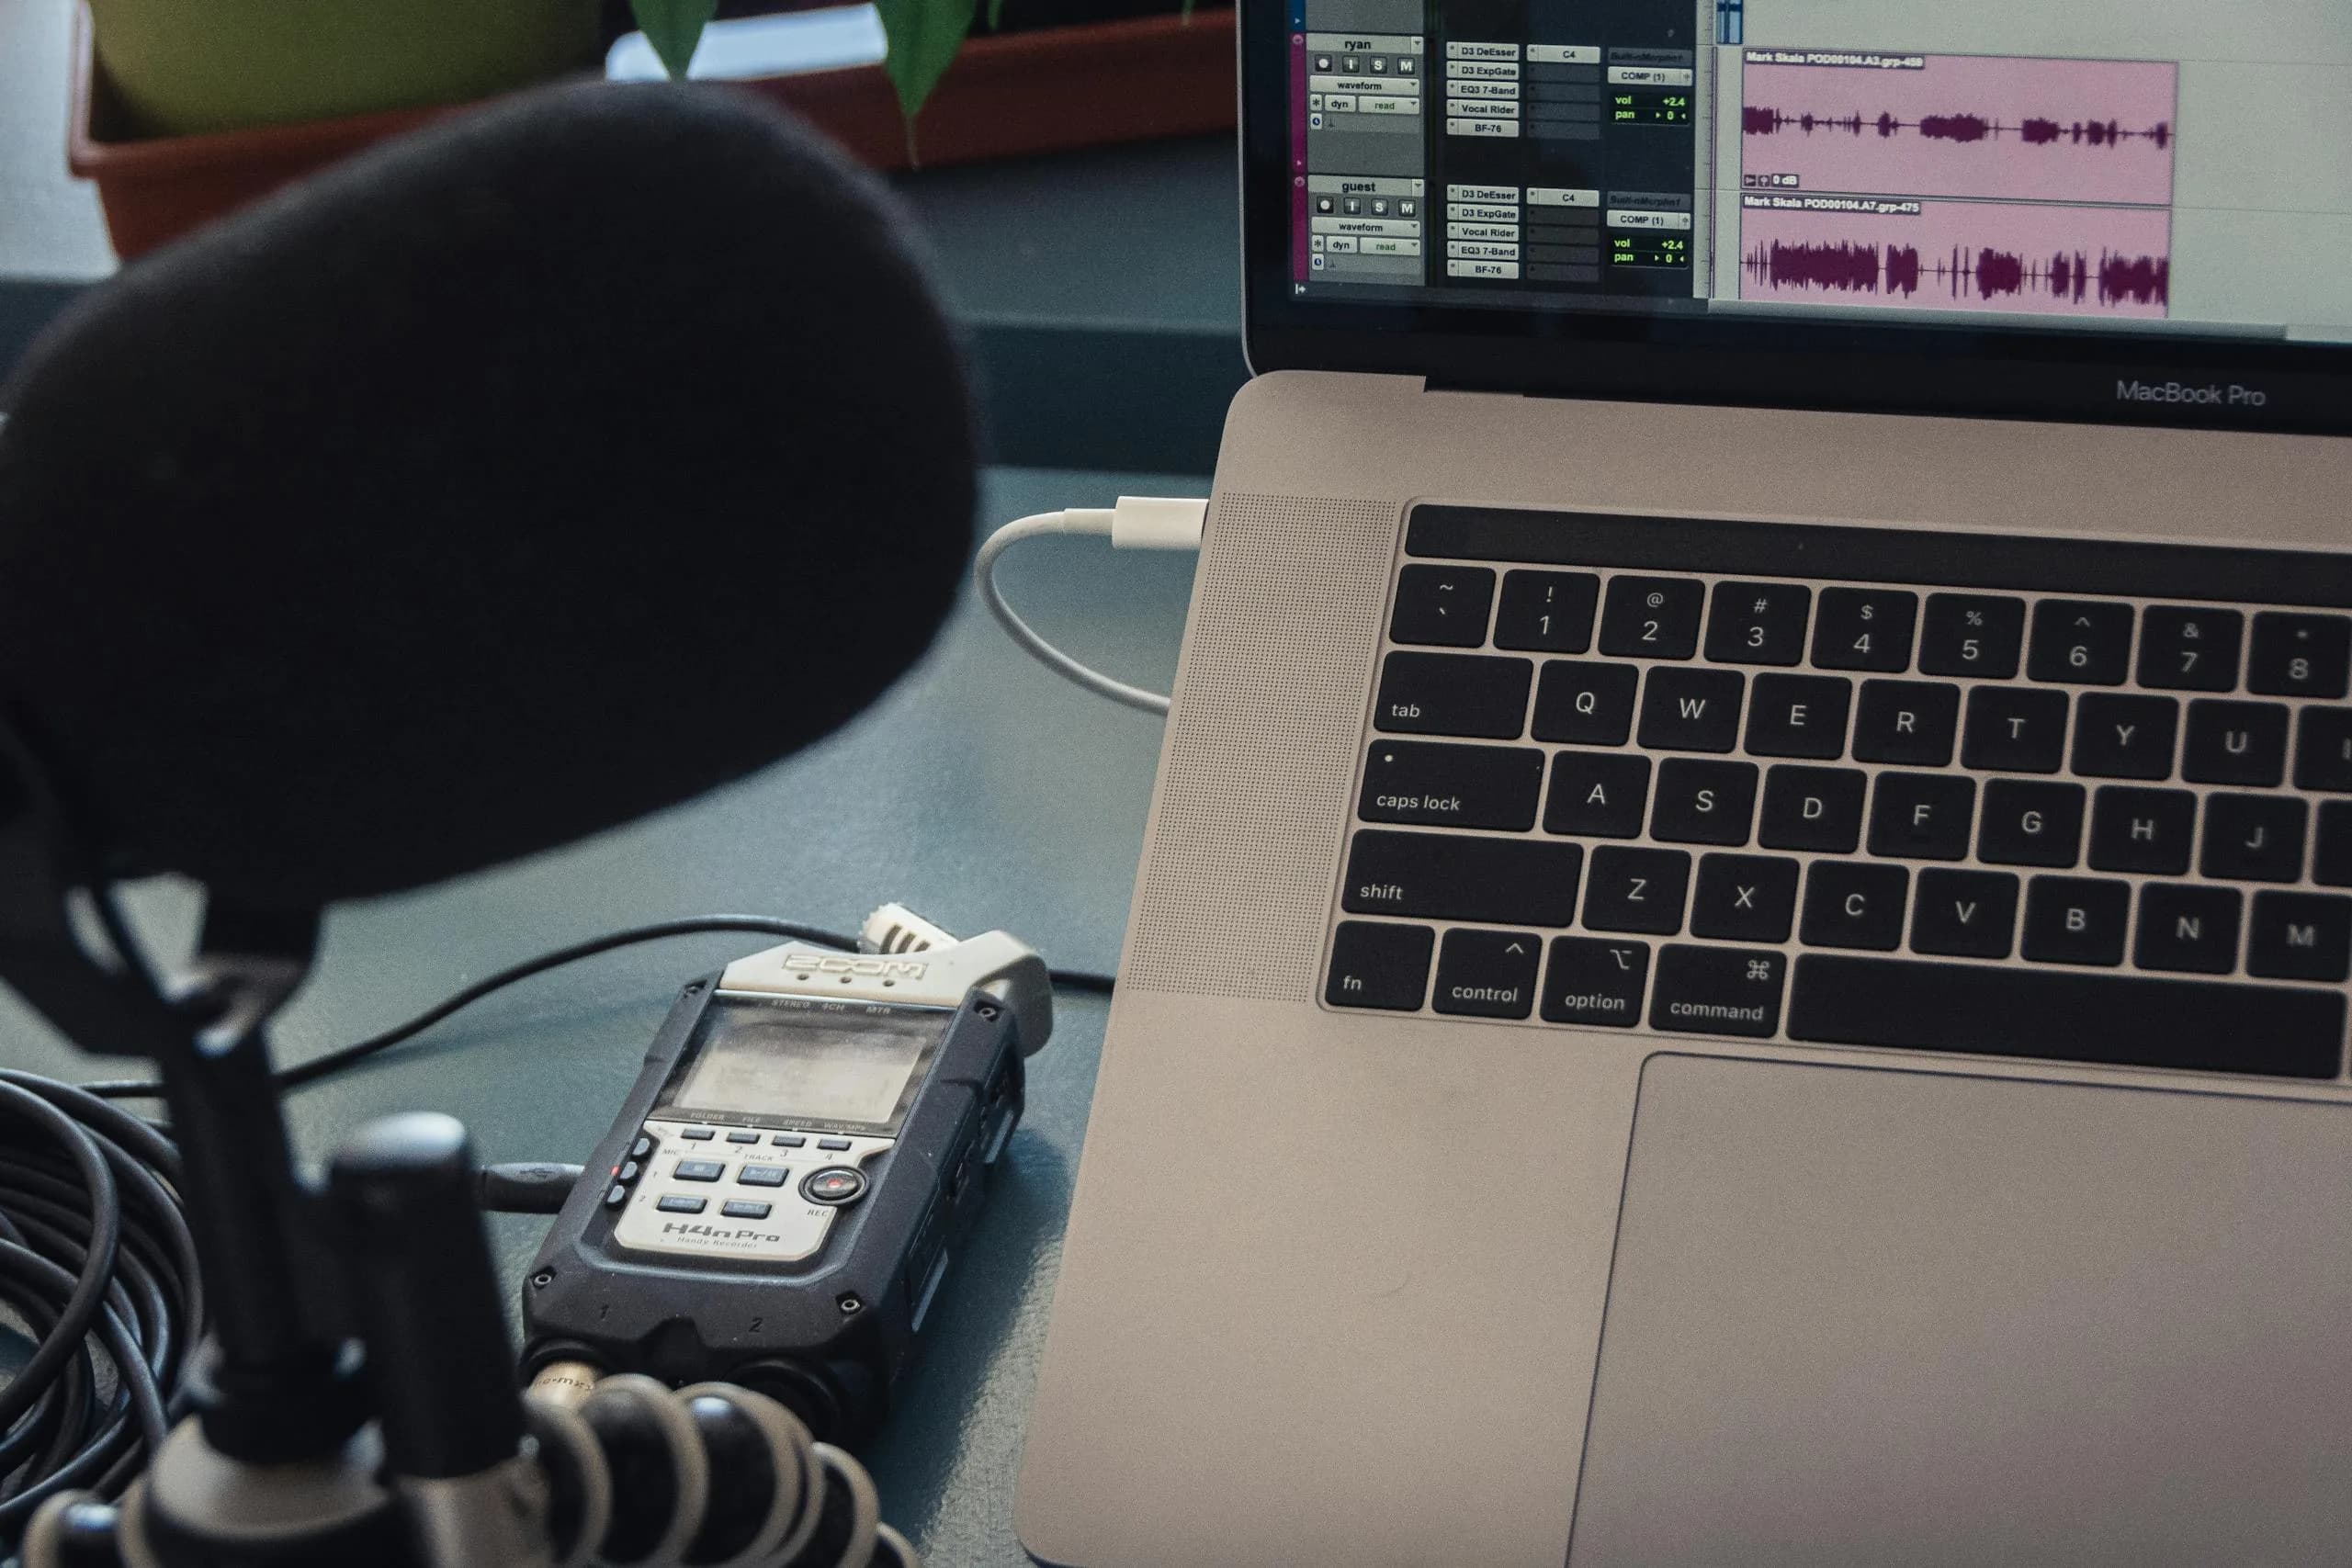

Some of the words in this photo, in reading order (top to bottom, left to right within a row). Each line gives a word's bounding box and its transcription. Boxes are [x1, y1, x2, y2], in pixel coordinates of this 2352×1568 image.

[1345, 40, 1372, 51] ryan
[1462, 47, 1475, 55] D3
[1476, 48, 1516, 57] DeEsser
[1563, 51, 1576, 59] C4
[1747, 51, 1773, 62] Mark
[1374, 60, 1383, 71] S
[1400, 62, 1412, 72] M
[1462, 66, 1475, 74] D3
[1476, 67, 1516, 76] ExpGate
[1622, 72, 1650, 80] COMP
[1654, 73, 1665, 82] (1)
[1338, 82, 1383, 90] waveform
[1461, 85, 1480, 94] EQ3
[1482, 85, 1516, 95] 7-Band
[1331, 100, 1349, 109] dyn
[1374, 102, 1395, 110] read
[1462, 104, 1487, 113] Vocal
[1490, 106, 1515, 114] Rider
[1615, 96, 1632, 105] vol
[1662, 97, 1686, 107] +2.4
[1615, 111, 1635, 120] pan
[1667, 111, 1675, 120] 0
[1475, 123, 1502, 132] BF-76
[1341, 182, 1376, 193] guest
[1782, 175, 1798, 185] dB
[1462, 189, 1475, 198] D3
[1476, 190, 1516, 200] DeEsser
[1562, 194, 1576, 203] C4
[1744, 196, 1770, 207] Mark
[1772, 197, 1803, 208] Skala
[1375, 202, 1384, 212] S
[1401, 203, 1413, 214] M
[1462, 209, 1475, 217] D3
[1476, 209, 1516, 220] ExpGate
[1339, 223, 1384, 232] waveform
[1620, 215, 1649, 223] COMP
[1652, 216, 1664, 226] (1)
[1462, 227, 1487, 236] Vocal
[1490, 229, 1515, 237] Rider
[1332, 241, 1350, 251] dyn
[1375, 243, 1396, 251] read
[1461, 246, 1480, 255] EQ3
[1482, 247, 1516, 256] 7-Band
[1613, 238, 1631, 247] vol
[1661, 240, 1684, 250] +2.4
[1613, 254, 1634, 263] pan
[1665, 254, 1673, 263] 0
[1475, 265, 1502, 275] BF-76
[2117, 379, 2222, 404] MacBook
[2227, 384, 2266, 406] Pro
[1646, 592, 1664, 608] @
[1754, 598, 1768, 613] #
[1860, 604, 1873, 620] $
[1965, 610, 1984, 626] %
[1540, 615, 1550, 635] 1
[1641, 620, 1658, 641] 2
[2182, 623, 2199, 638] &
[1747, 626, 1764, 647] 3
[1853, 633, 1871, 653] 4
[1962, 638, 1978, 660] 5
[2069, 645, 2087, 667] 6
[2182, 651, 2199, 672] 7
[2290, 658, 2309, 680] 8
[1576, 691, 1595, 715] Q
[1679, 697, 1706, 719] W
[1392, 704, 1420, 718] tab
[1790, 705, 1807, 726] E
[1896, 711, 1916, 733] R
[2007, 717, 2025, 739] T
[2116, 725, 2134, 746] Y
[2225, 731, 2247, 754] U
[1587, 784, 1606, 805] A
[1695, 790, 1714, 812] S
[1376, 795, 1419, 810] caps
[1423, 795, 1461, 811] lock
[1803, 796, 1823, 819] D
[1913, 804, 1931, 826] F
[2021, 810, 2041, 833] G
[2132, 818, 2154, 840] H
[2245, 827, 2264, 849] J
[1360, 884, 1403, 900] shift
[1627, 878, 1647, 900] Z
[1735, 886, 1755, 908] X
[1845, 893, 1865, 916] C
[1955, 900, 1976, 924] V
[2066, 908, 2086, 931] B
[2177, 917, 2199, 940] N
[2289, 924, 2315, 946] M
[782, 954, 928, 980] ZOOM
[1343, 975, 1363, 990] fn
[1452, 987, 1518, 1003] control
[1565, 993, 1625, 1010] option
[866, 1006, 891, 1014] MTR
[1670, 1002, 1764, 1021] command
[691, 1111, 725, 1121] FOLDER
[783, 1118, 812, 1127] SPEED
[691, 1142, 697, 1150] 1
[735, 1145, 743, 1154] 2
[780, 1149, 787, 1157] 3
[826, 1153, 833, 1161] 4
[808, 1209, 828, 1217] REC
[662, 1222, 731, 1239] H4n
[735, 1230, 780, 1242] Pro
[677, 1236, 711, 1246] Handy
[713, 1239, 757, 1248] Recorder
[601, 1303, 609, 1321] 1
[749, 1317, 763, 1332] 2
